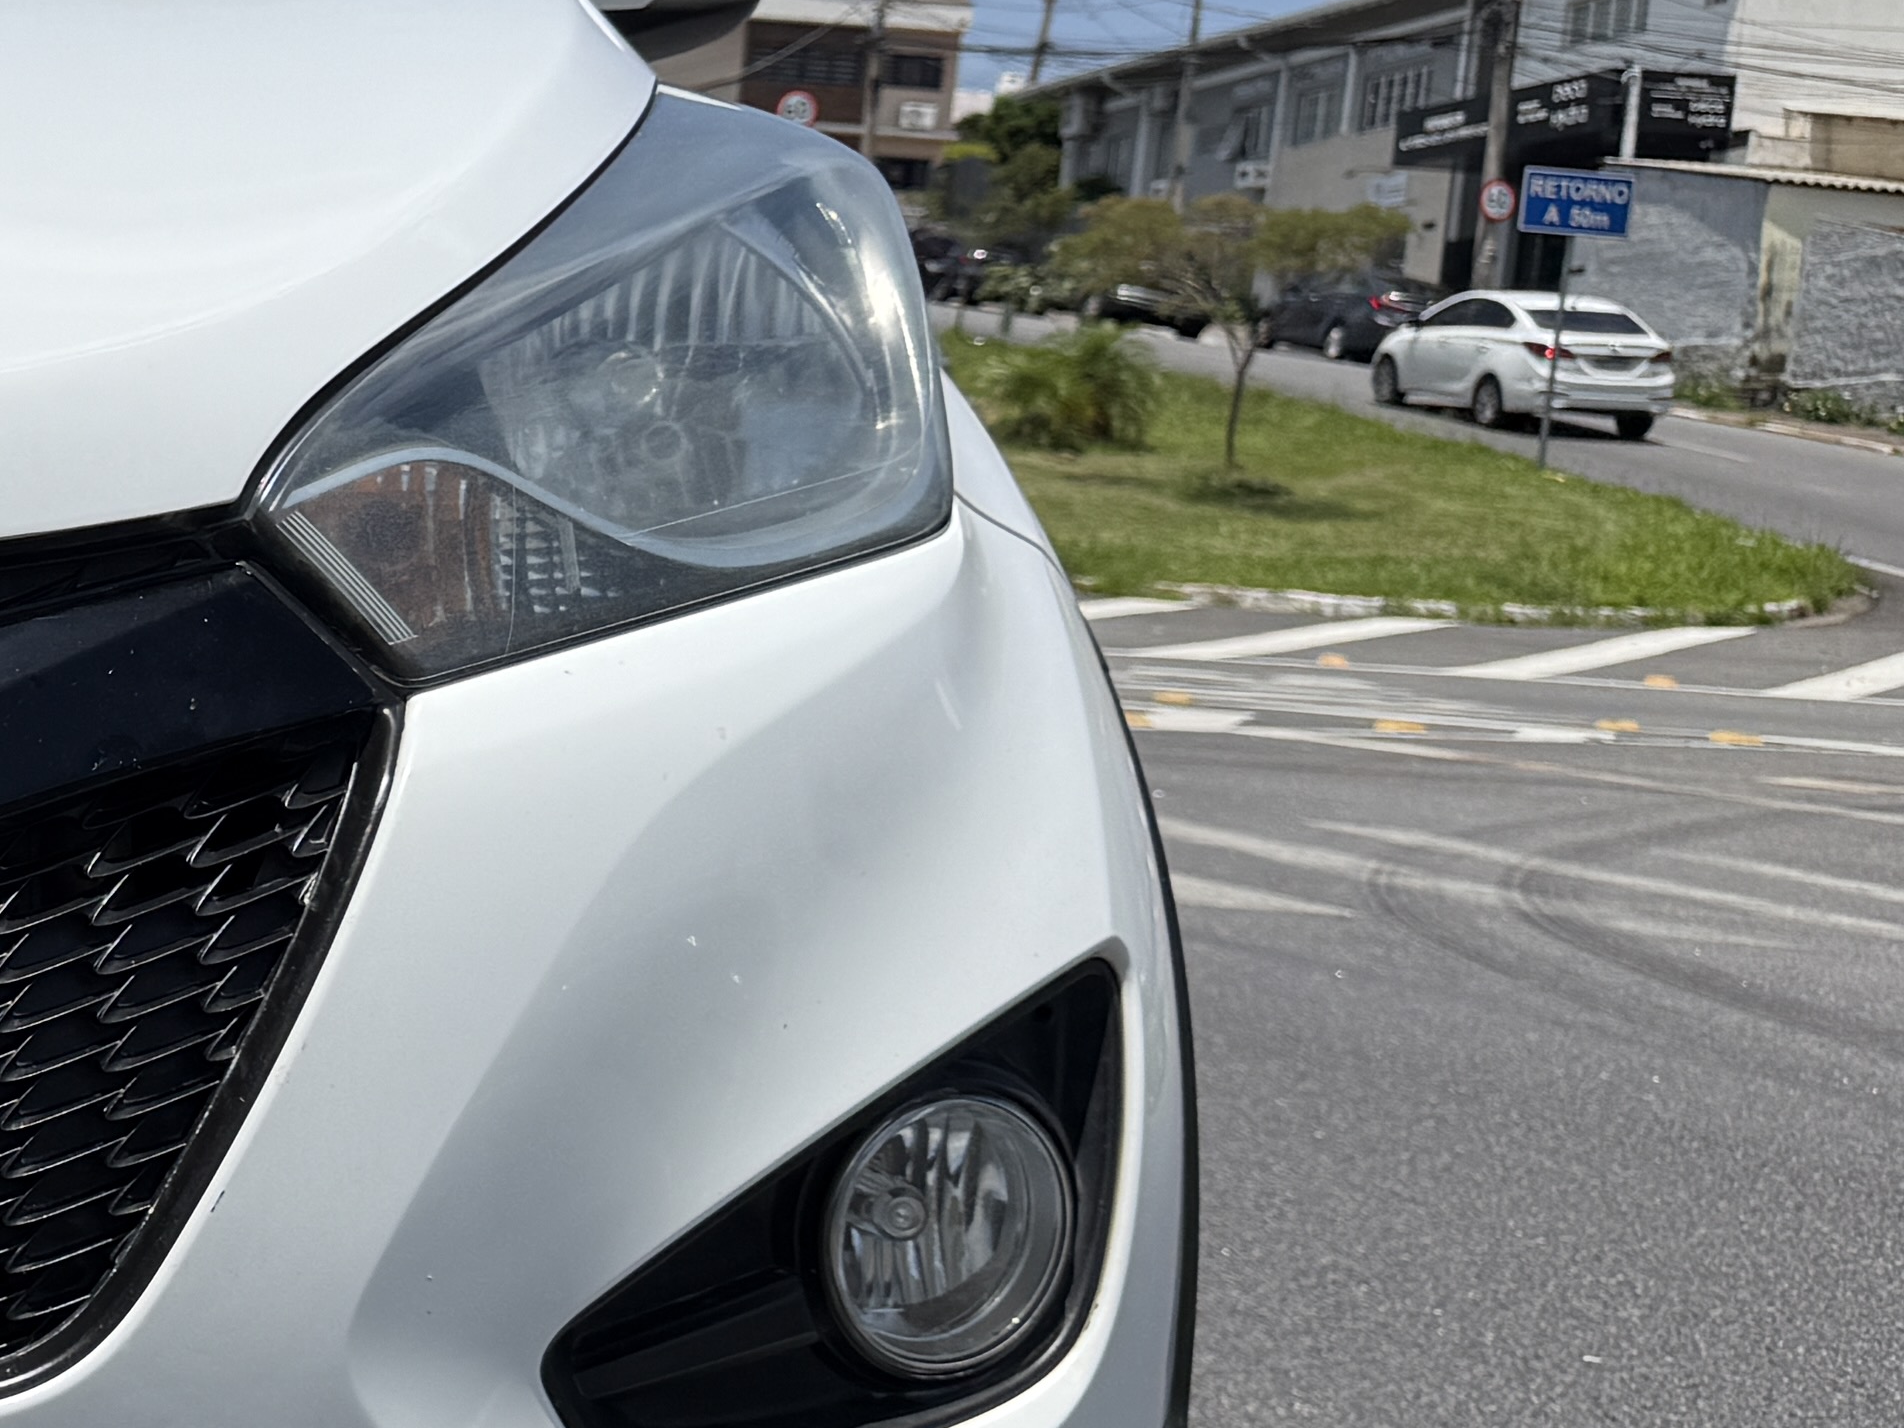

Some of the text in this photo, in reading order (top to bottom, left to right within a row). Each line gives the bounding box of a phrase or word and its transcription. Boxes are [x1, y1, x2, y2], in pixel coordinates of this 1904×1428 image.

[1529, 175, 1630, 205] RETORNO
[1542, 202, 1611, 230] A 50m
